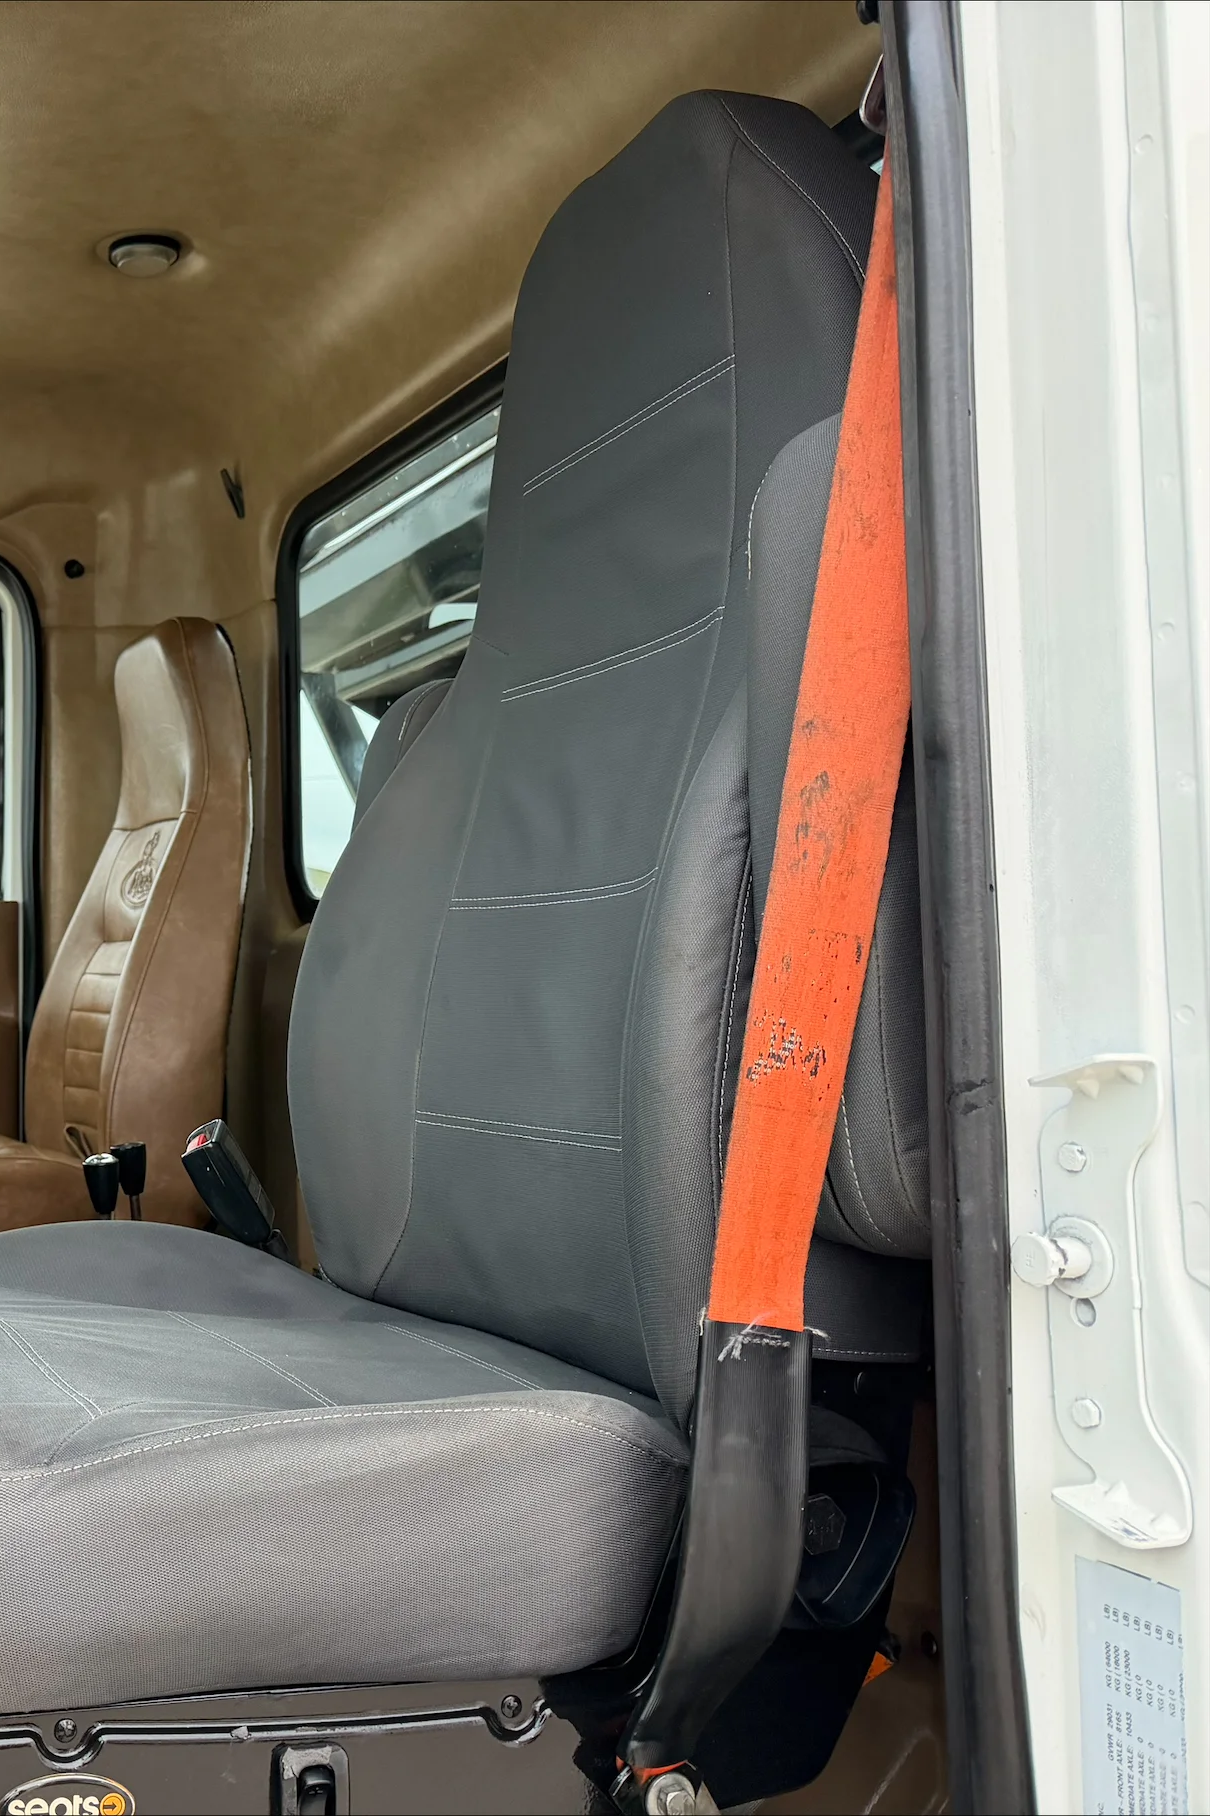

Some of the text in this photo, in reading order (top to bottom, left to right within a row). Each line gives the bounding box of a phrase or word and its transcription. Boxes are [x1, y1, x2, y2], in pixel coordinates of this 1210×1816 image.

[1123, 1612, 1131, 1627] LB)
[1155, 1625, 1163, 1641] LB)
[1167, 1630, 1175, 1645] LB)
[1106, 1675, 1112, 1689] KG
[1114, 1678, 1121, 1693] KG
[1125, 1683, 1132, 1698] KG
[1136, 1688, 1143, 1703] KG
[1146, 1693, 1153, 1707] KG
[1157, 1698, 1165, 1713] KG
[1169, 1703, 1176, 1718] KG
